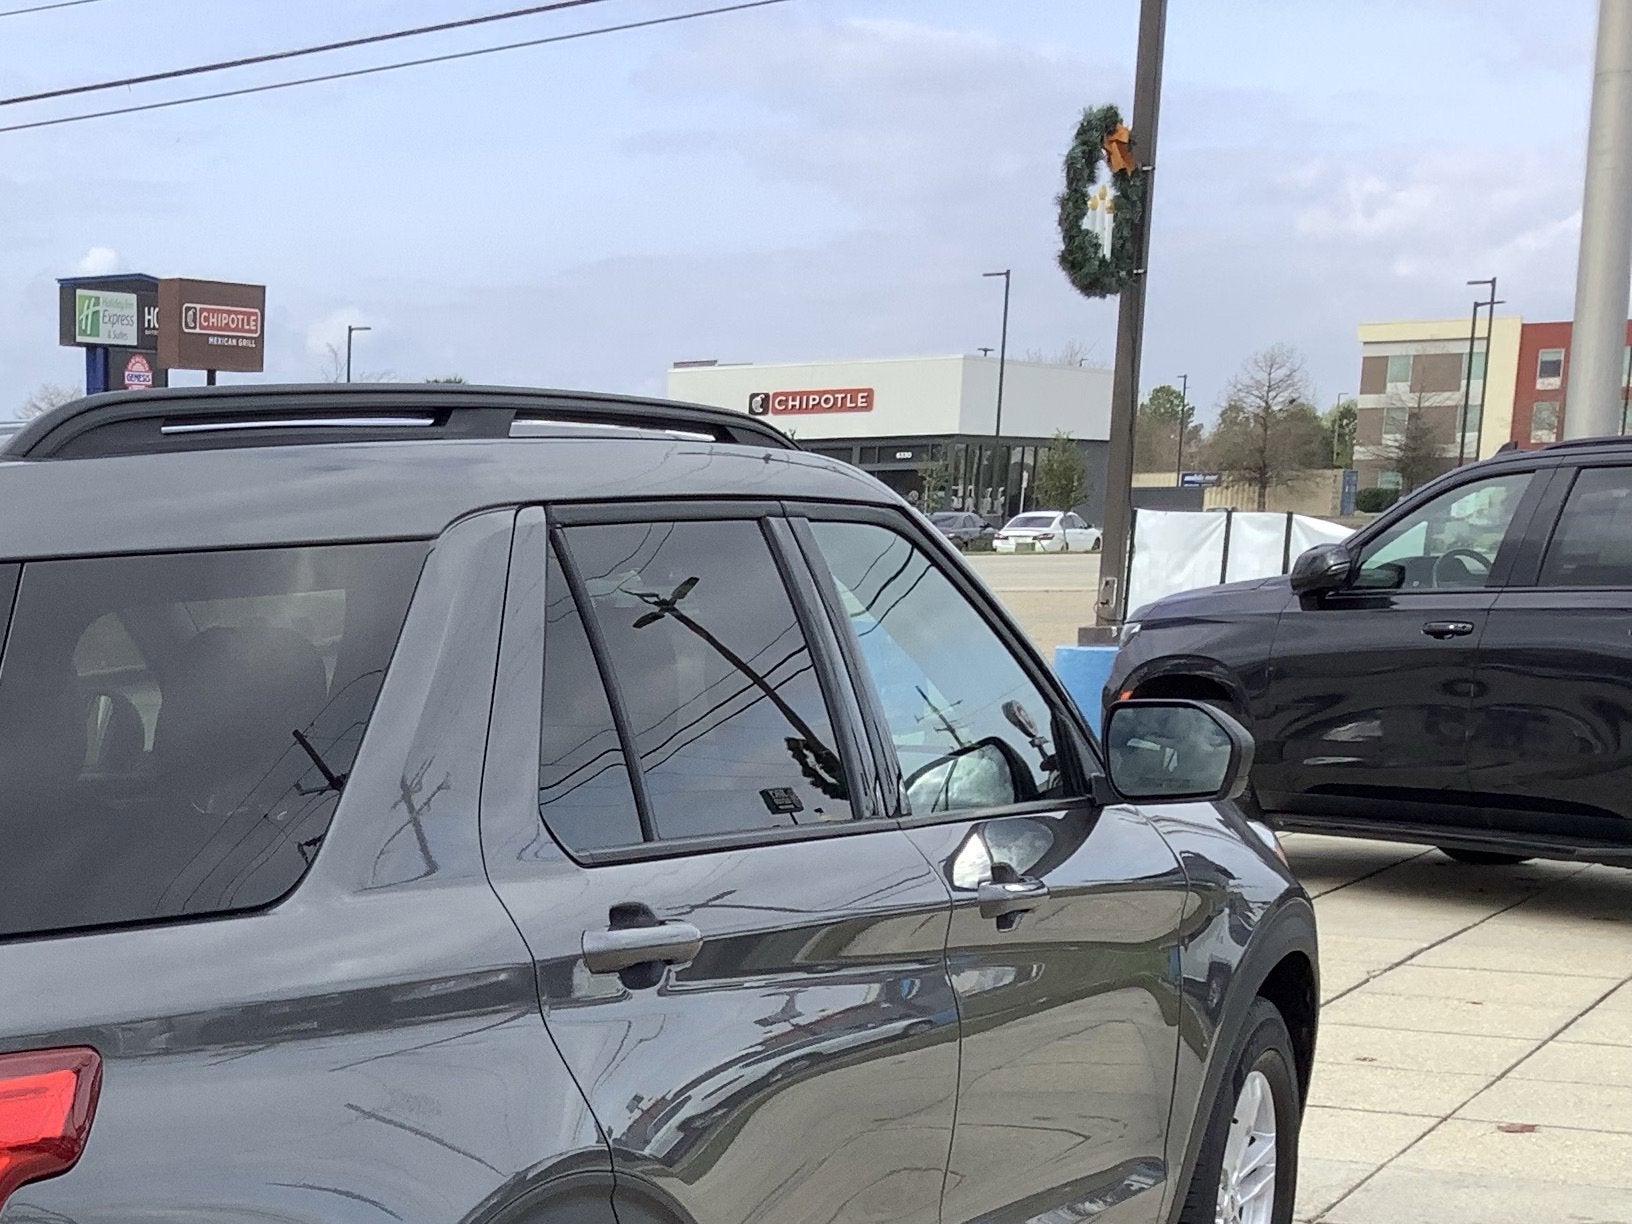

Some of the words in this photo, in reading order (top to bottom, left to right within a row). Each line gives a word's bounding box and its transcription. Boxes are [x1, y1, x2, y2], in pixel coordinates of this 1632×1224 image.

[102, 309, 135, 327] Express
[200, 311, 257, 330] CHIPOTLE
[208, 336, 237, 346] MEXICAN
[238, 338, 256, 348] GRILL
[774, 392, 869, 410] CHIPOTLE
